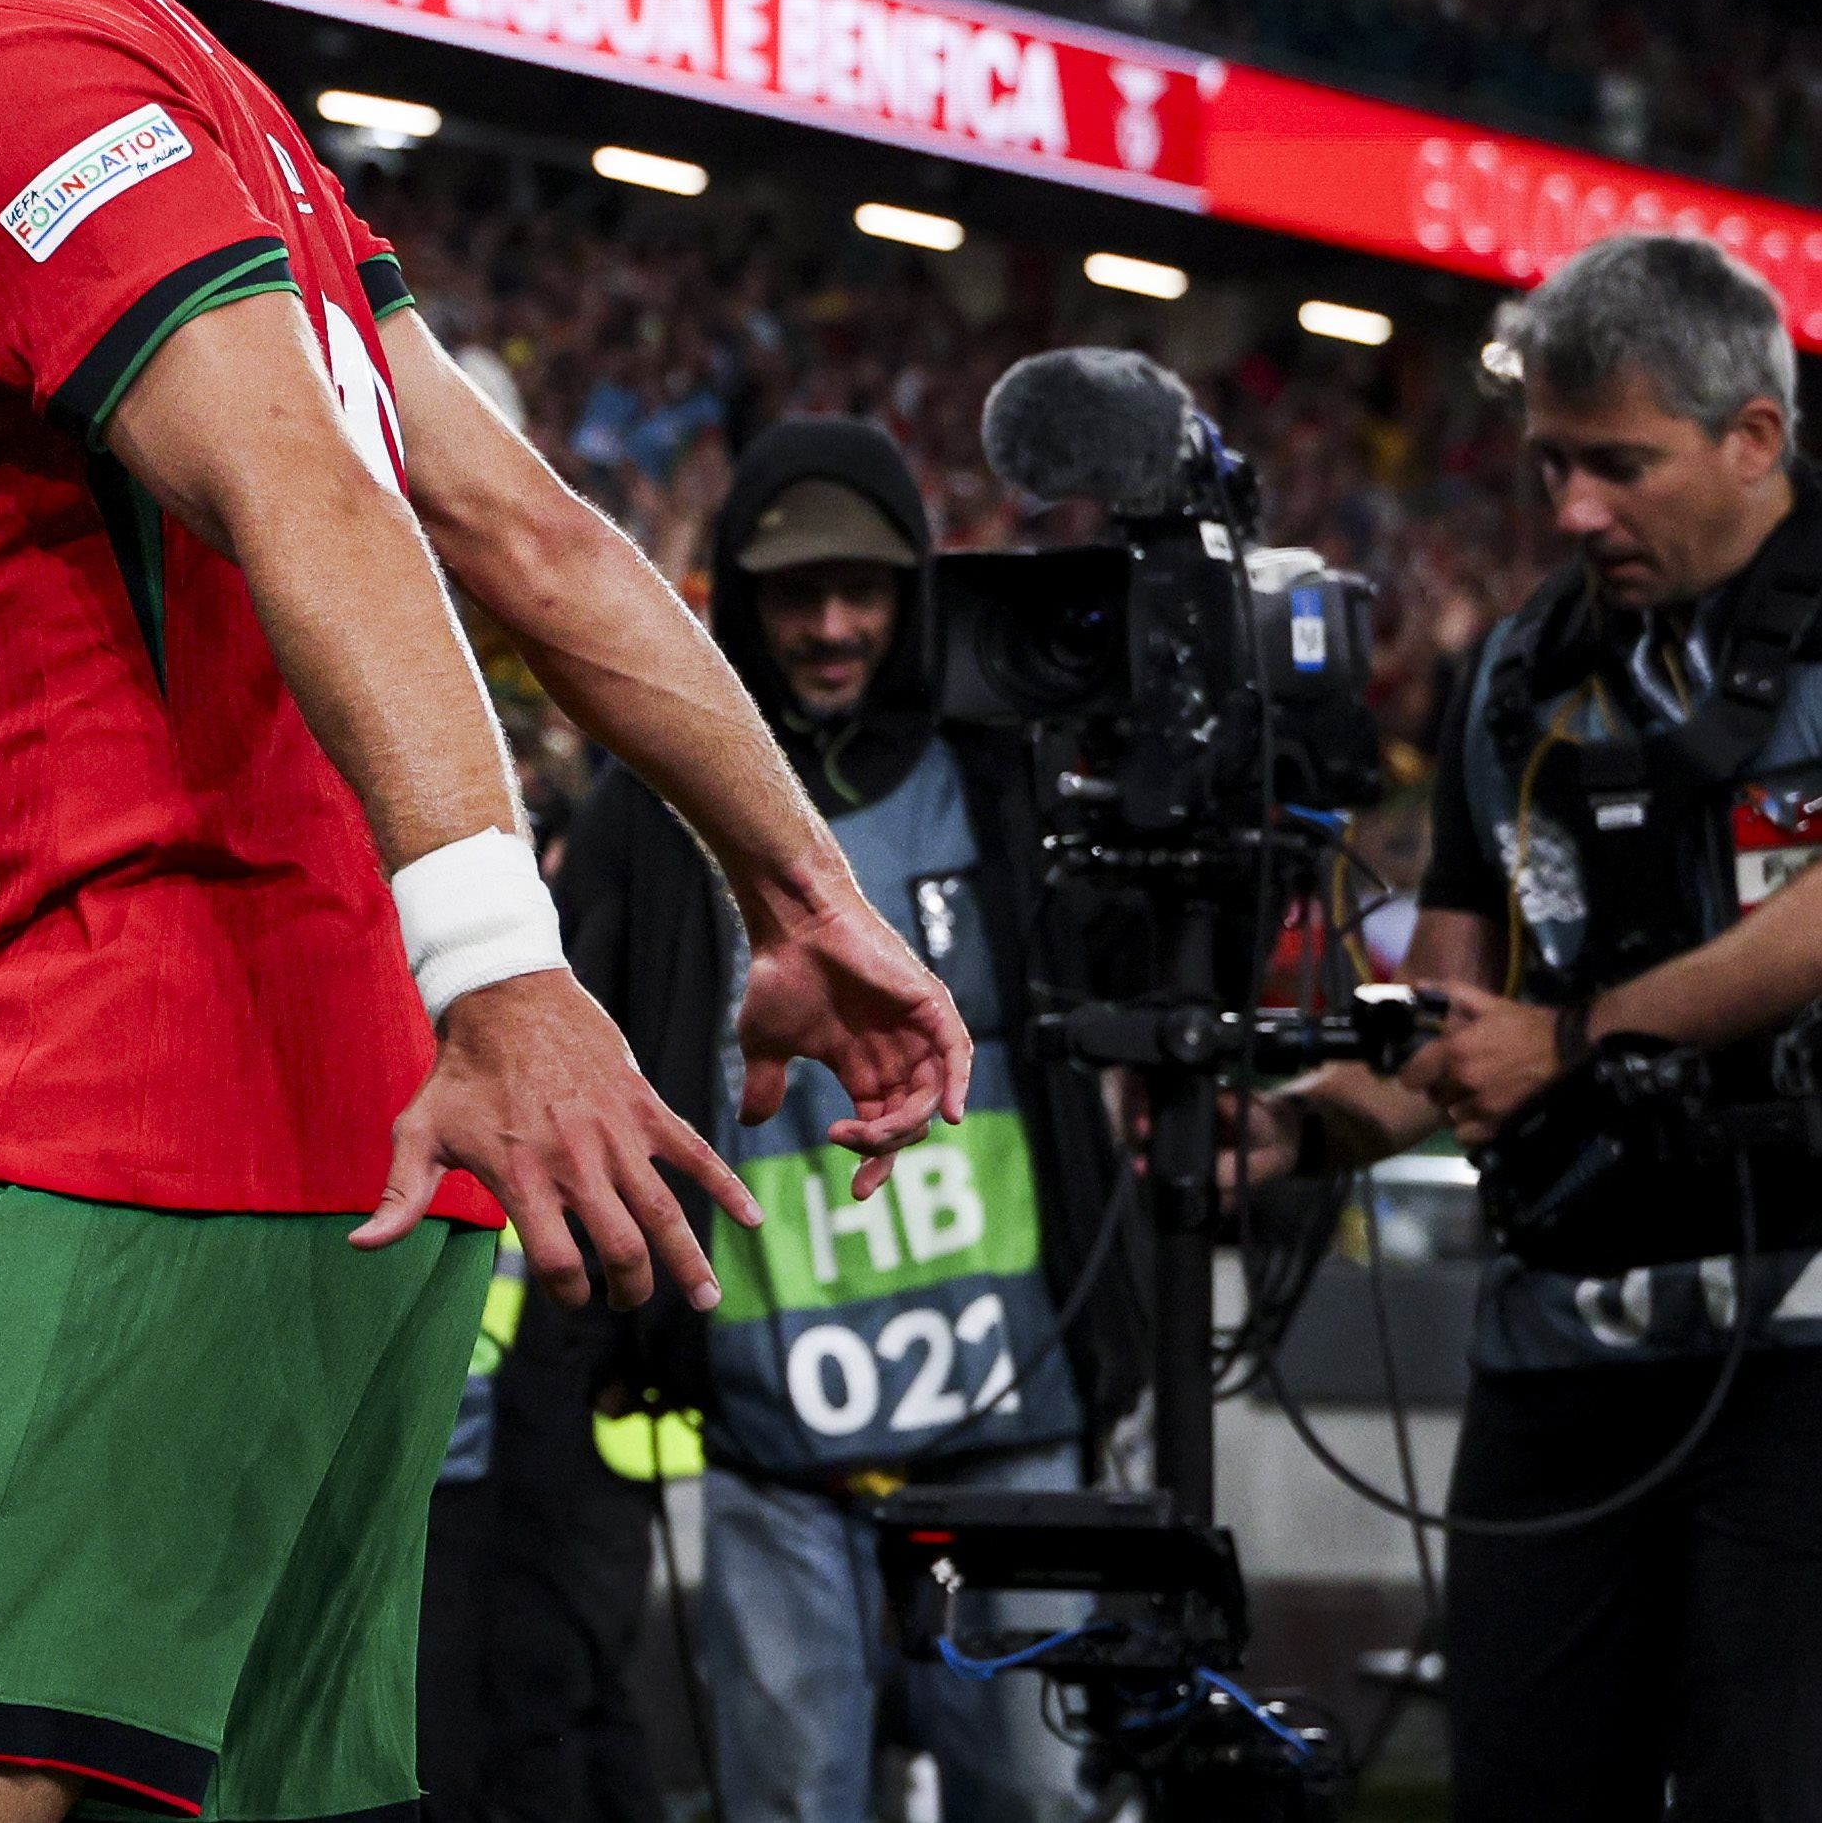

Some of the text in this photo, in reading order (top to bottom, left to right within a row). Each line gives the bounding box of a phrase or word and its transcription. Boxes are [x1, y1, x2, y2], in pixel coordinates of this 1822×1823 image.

[137, 144, 185, 176] for children
[5, 190, 41, 226] UEFA
[804, 1145, 985, 1284] HB
[787, 1294, 1019, 1436] 022
